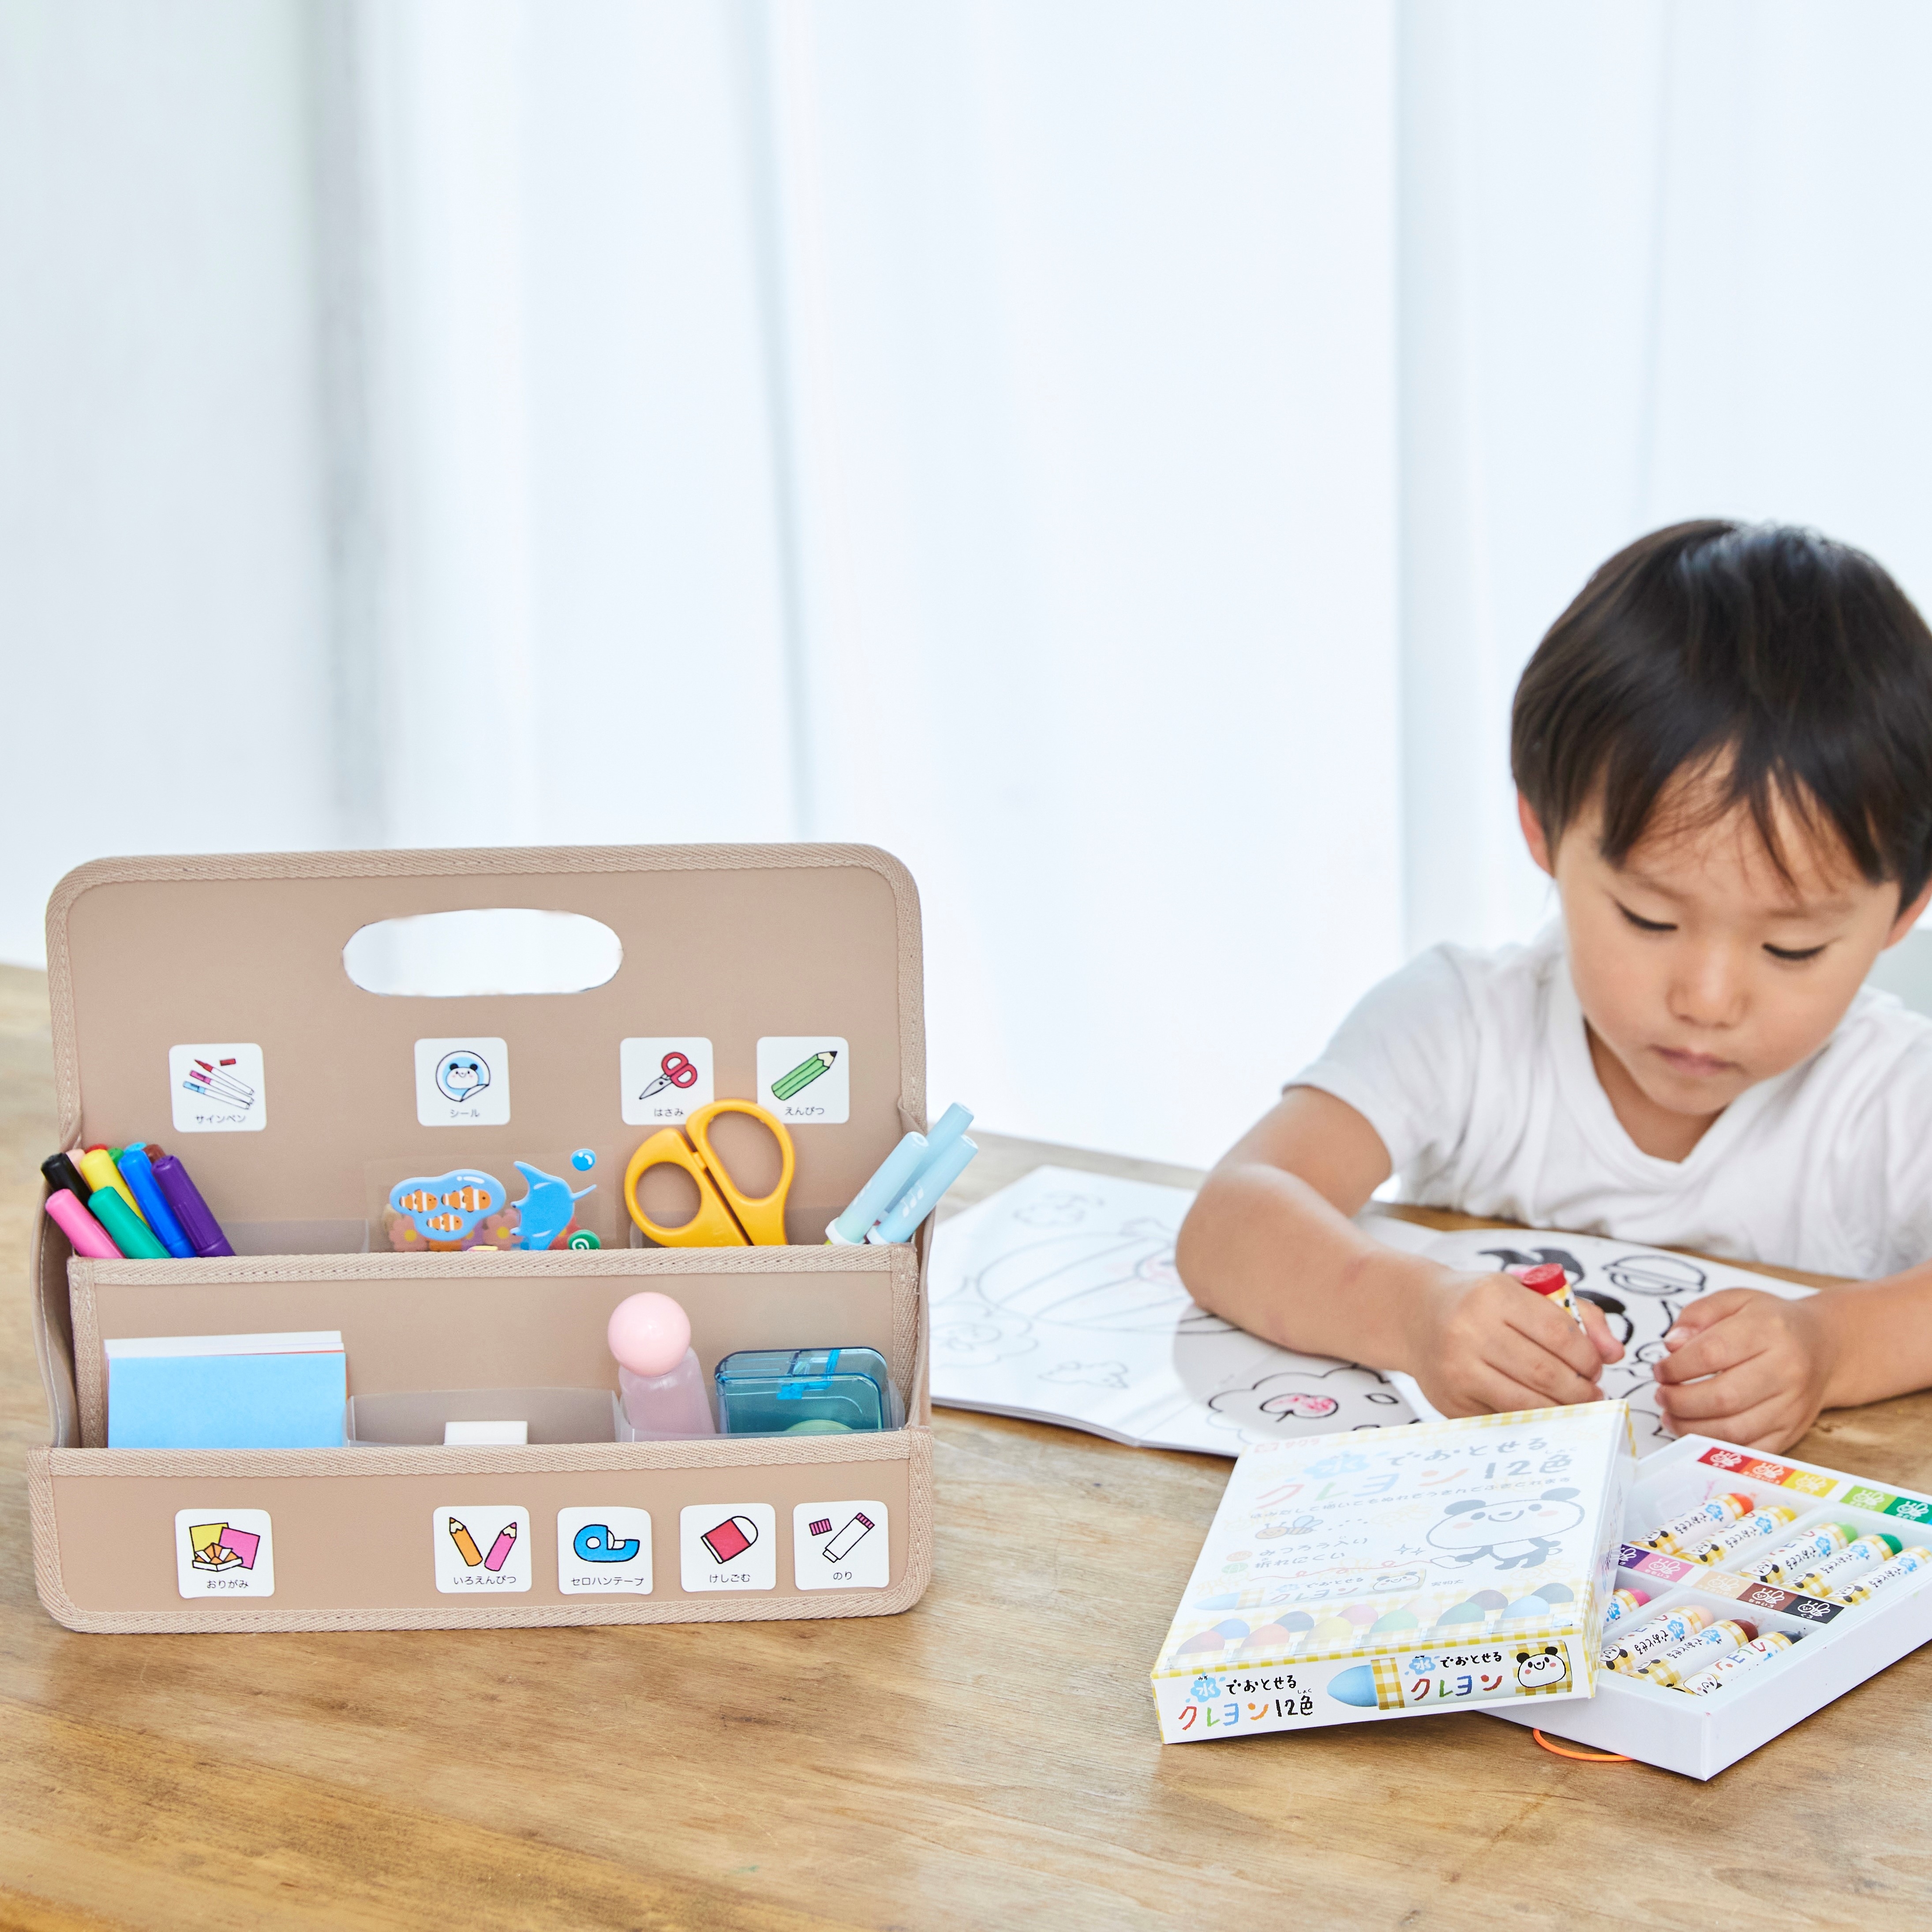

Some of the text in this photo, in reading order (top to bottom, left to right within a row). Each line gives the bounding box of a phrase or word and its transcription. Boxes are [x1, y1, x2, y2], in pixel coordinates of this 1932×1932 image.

[450, 1109, 480, 1118] シール
[654, 1108, 684, 1117] はさみ
[785, 1106, 824, 1116] えんぴつ
[195, 1115, 246, 1124] サインペン
[453, 1575, 517, 1585] いろえんぴつ
[709, 1573, 750, 1583] けしごむ
[833, 1571, 852, 1580] のり
[207, 1580, 249, 1589] おりがみ
[571, 1577, 644, 1586] セロハンテープ
[1411, 1674, 1503, 1701] クレヨン
